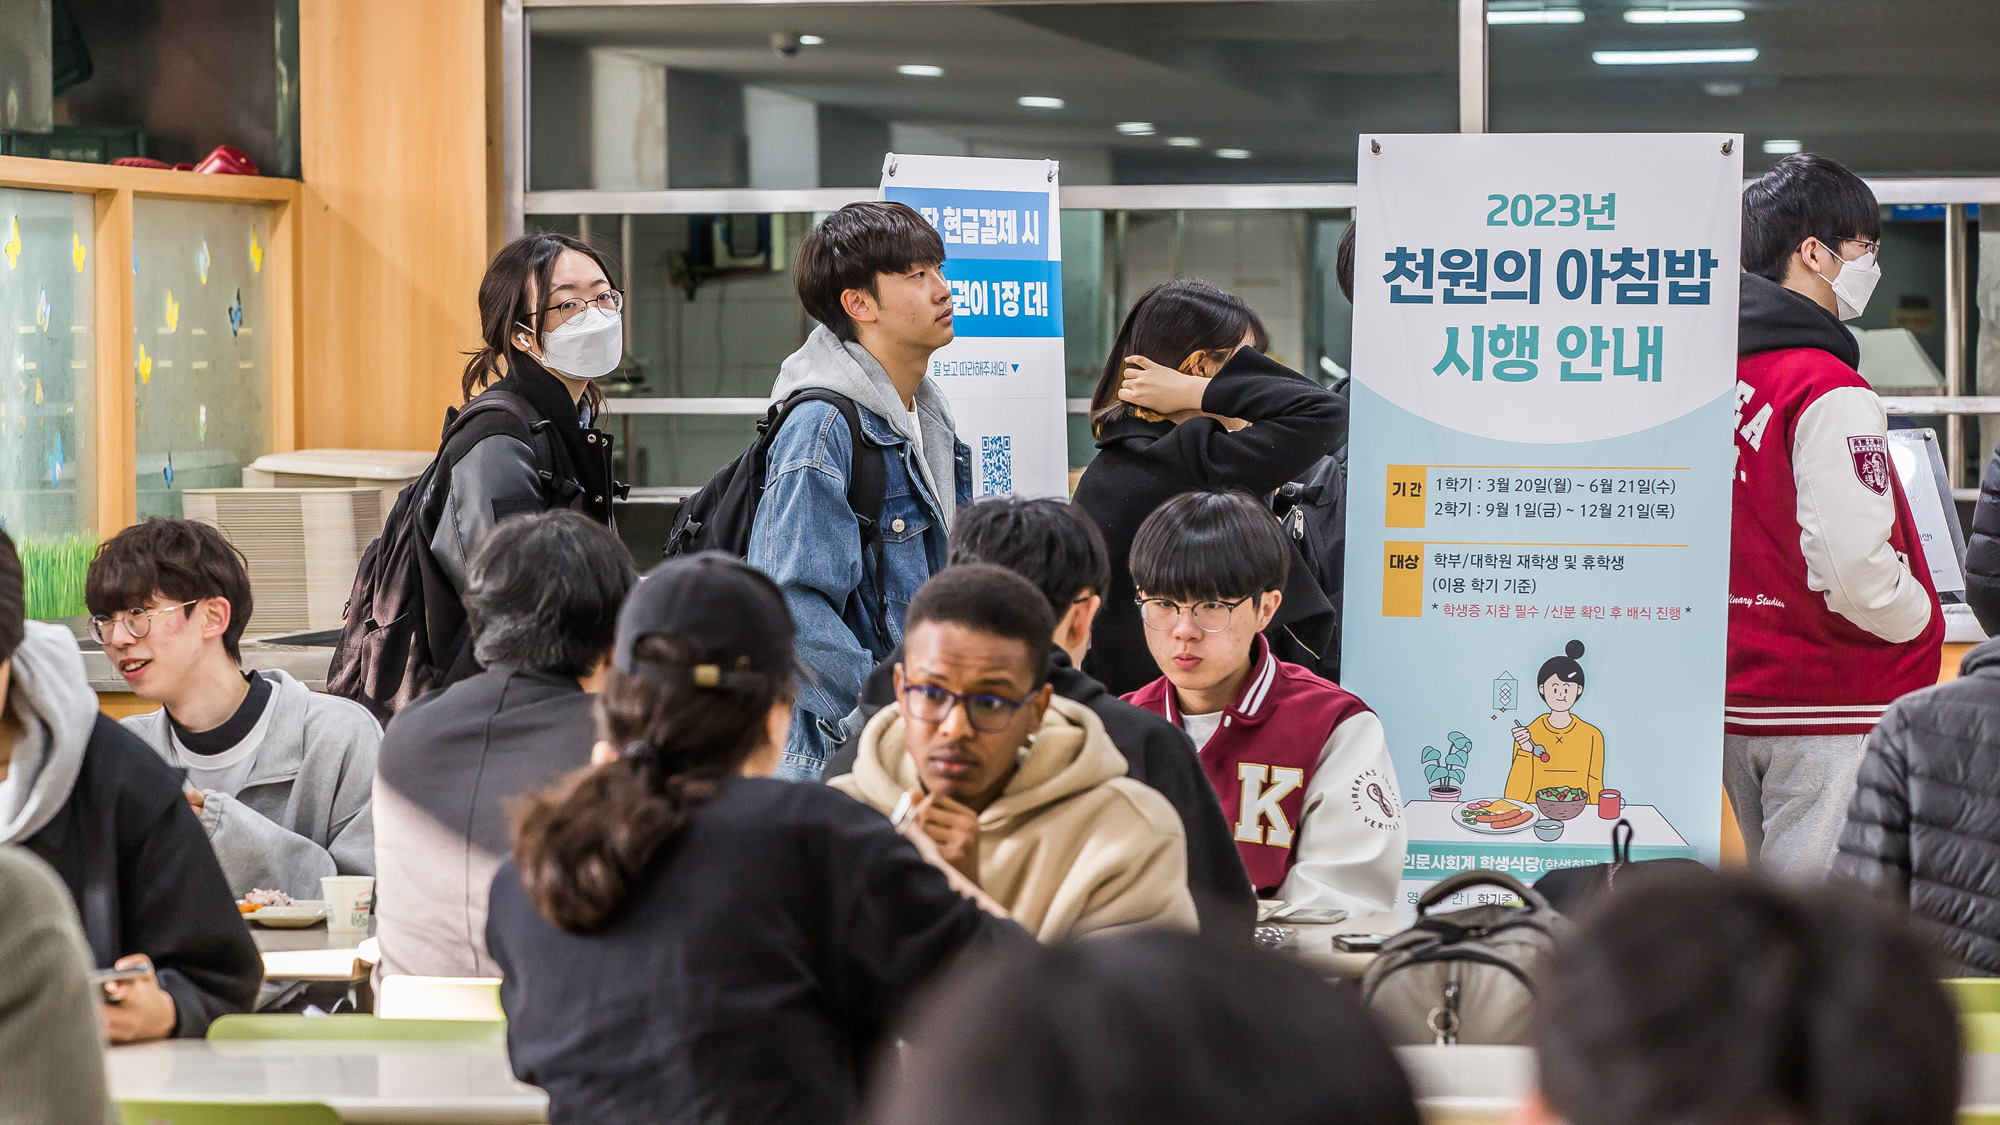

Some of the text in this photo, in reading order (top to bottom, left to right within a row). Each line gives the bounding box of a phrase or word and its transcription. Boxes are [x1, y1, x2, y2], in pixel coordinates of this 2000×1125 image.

[1486, 192, 1616, 231] 2023년
[943, 206, 1018, 245] 현금결제
[1021, 210, 1040, 245] 시
[1382, 246, 1719, 306] 천원의 아침밥
[946, 280, 989, 316] 권이
[992, 281, 1020, 317] 1장
[1432, 323, 1664, 383] 시행 안내
[933, 361, 941, 376] 잘
[943, 361, 958, 376] 보고
[1436, 477, 1472, 493] 1학기
[1487, 478, 1510, 493] 3월
[1514, 477, 1572, 494] 20일(월)
[1589, 478, 1613, 494] 6월
[1618, 478, 1676, 495] 21일(수)
[1434, 502, 1471, 517] 2학기
[1486, 502, 1509, 518] 9월
[1515, 502, 1562, 518] 1일(금)
[1580, 503, 1612, 518] 12월
[1617, 503, 1675, 519] 21일(목)
[1389, 554, 1420, 570] 대상
[1434, 553, 1625, 571] 학부/대학원 재학생 및 휴학생
[1432, 577, 1537, 594] (이용 학기 기준)
[1755, 594, 1785, 608] Studies
[1443, 603, 1481, 618] 학생증
[1485, 604, 1511, 618] 지참
[1514, 604, 1540, 618] 필수
[1580, 605, 1606, 619] 확인
[1609, 605, 1623, 620] 후
[1626, 606, 1652, 620] 배식
[1655, 606, 1681, 621] 진행
[1351, 769, 1377, 811] LIBERTAS
[1234, 762, 1304, 849] K
[1403, 854, 1476, 870] 인문사회계
